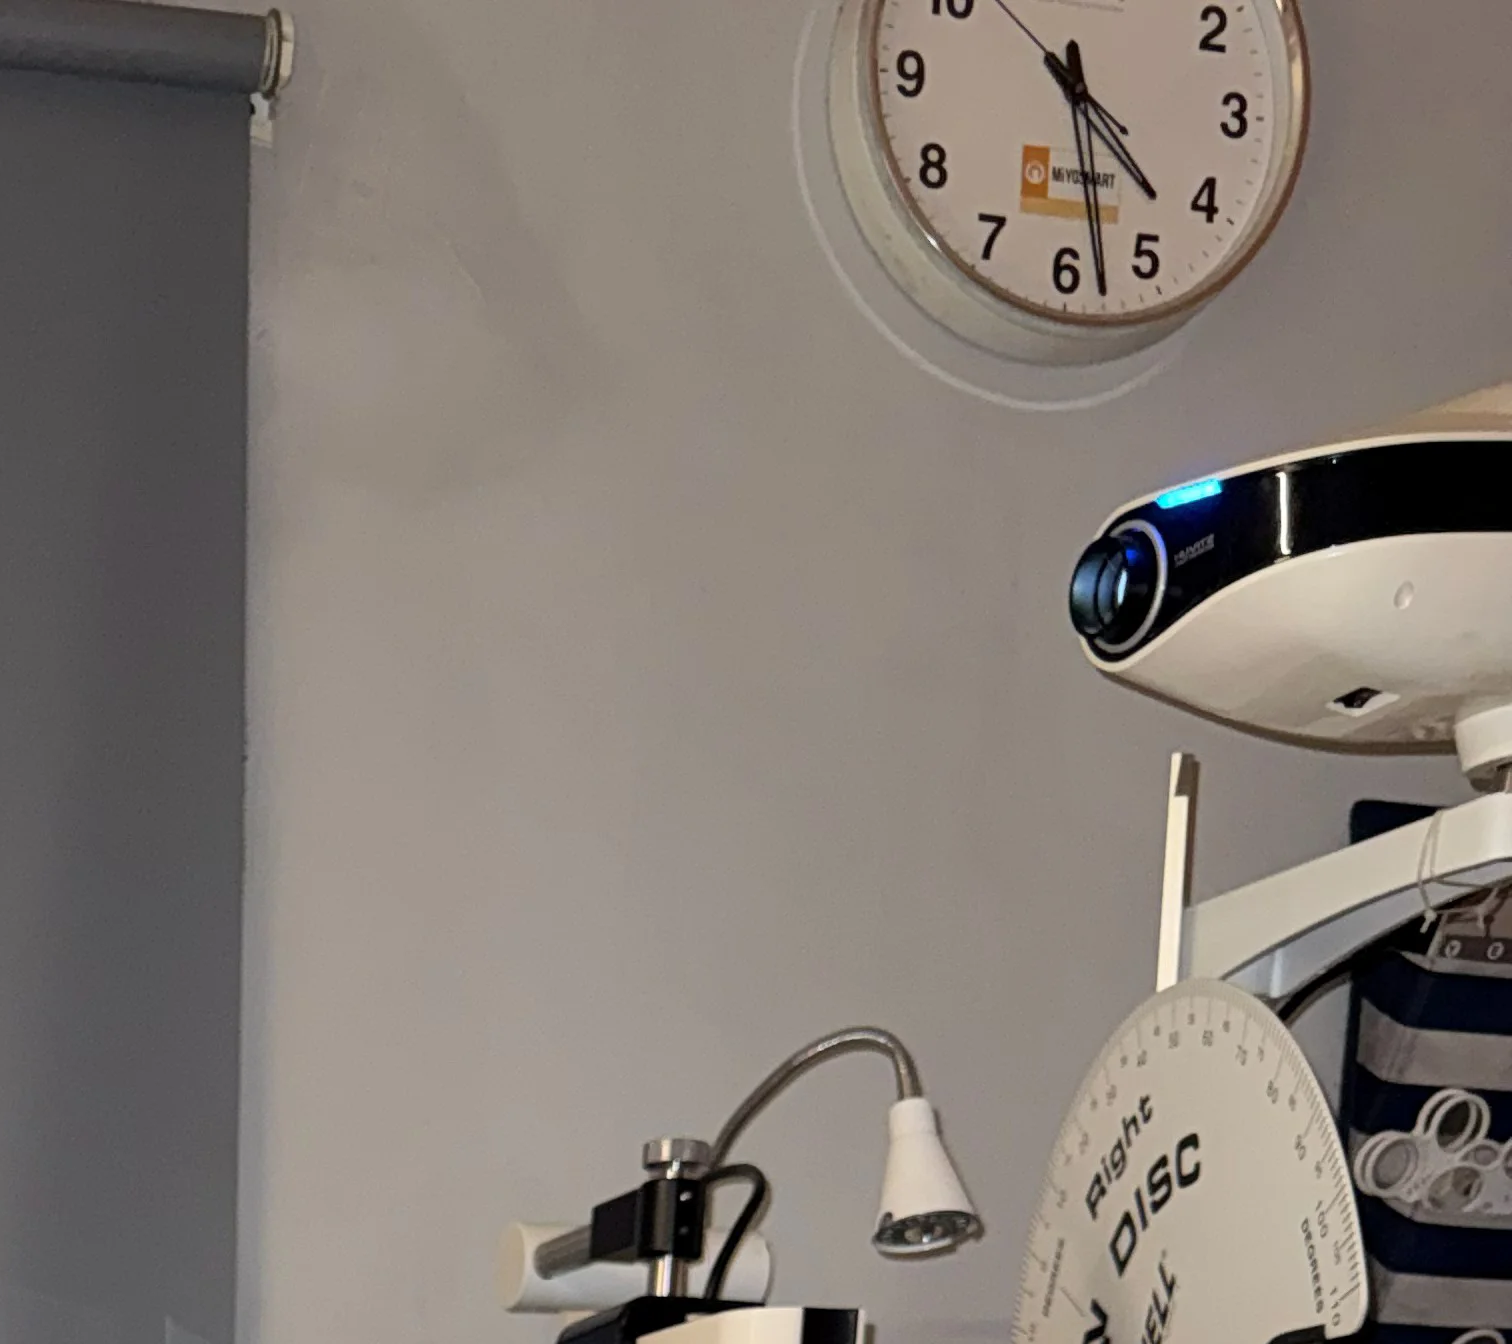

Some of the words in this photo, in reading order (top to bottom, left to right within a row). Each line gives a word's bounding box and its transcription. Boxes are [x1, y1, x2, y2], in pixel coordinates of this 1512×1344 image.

[1198, 6, 1228, 53] 2
[895, 50, 925, 98] 9
[1219, 92, 1248, 139] 3
[918, 143, 948, 189] 8
[1051, 166, 1116, 189] MiYOART
[1191, 177, 1219, 223] 4
[977, 213, 1007, 260] 7
[1131, 233, 1161, 280] 5
[1052, 247, 1080, 294] 6
[1085, 1094, 1154, 1221] Right
[1109, 1132, 1202, 1279] DISC
[1314, 1199, 1329, 1239] 100
